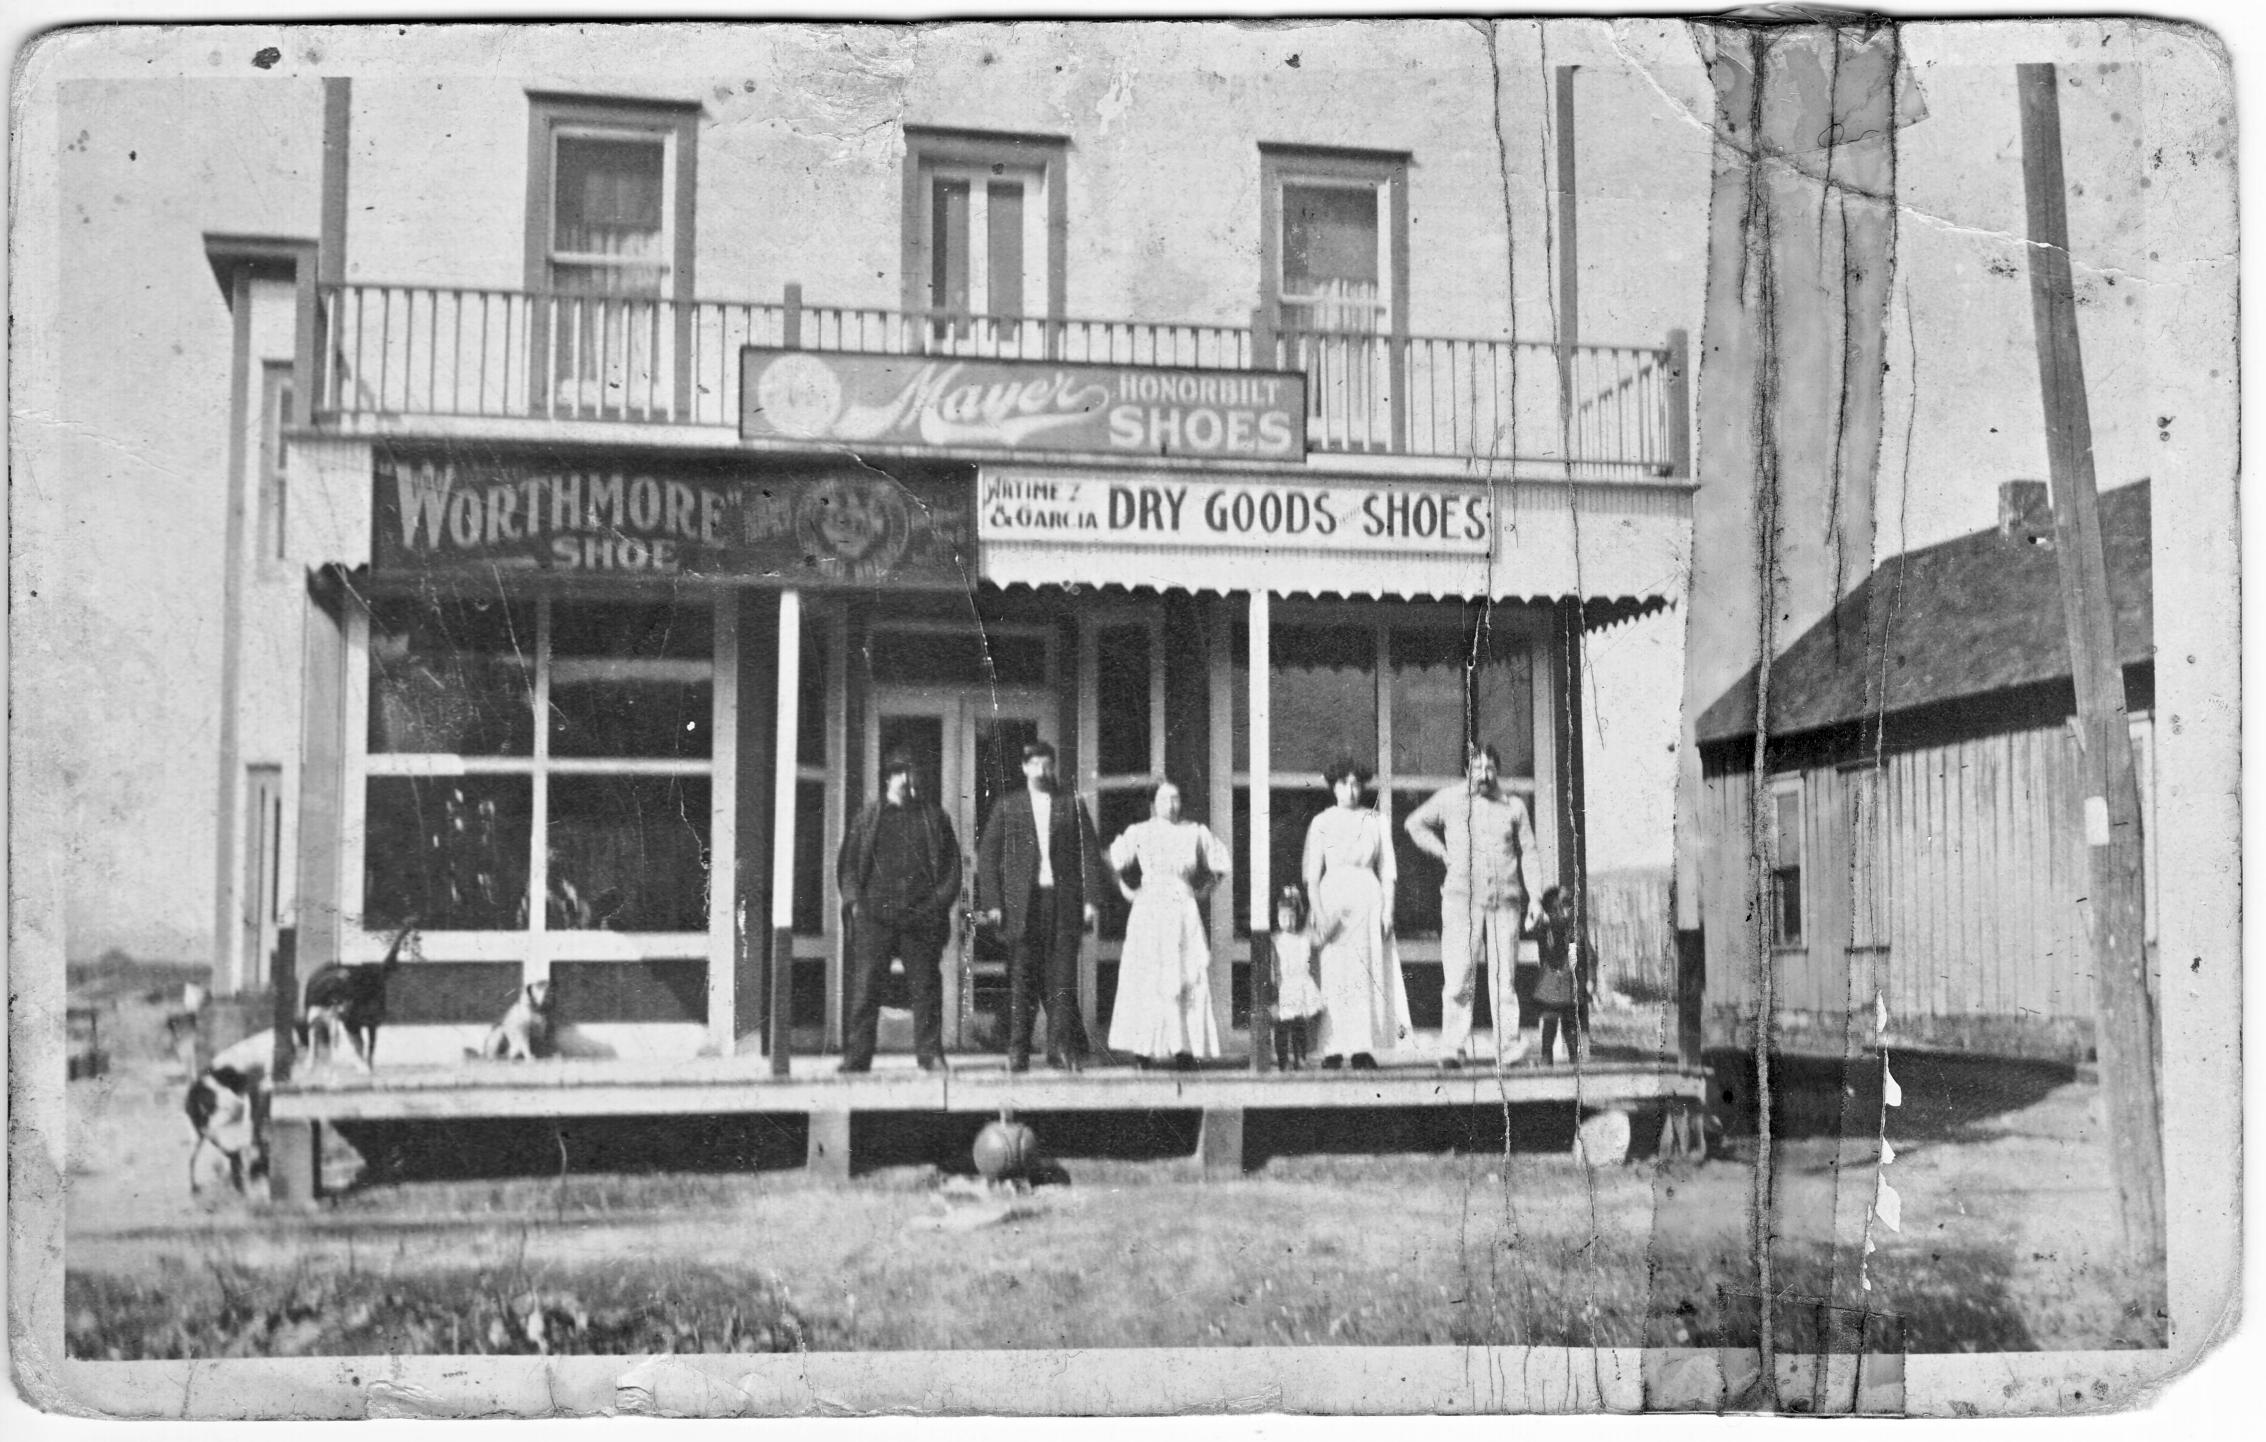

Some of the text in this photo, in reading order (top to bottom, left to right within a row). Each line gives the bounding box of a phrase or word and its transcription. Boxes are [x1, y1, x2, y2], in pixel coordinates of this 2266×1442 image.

[832, 362, 1108, 444] Mayer
[1119, 374, 1280, 406] HONORBILT
[1107, 405, 1292, 453] SHOES
[1016, 507, 1098, 529] GARCIA
[1108, 486, 1486, 540] DRY GOODS SHOES
[552, 536, 679, 571] SHOE
